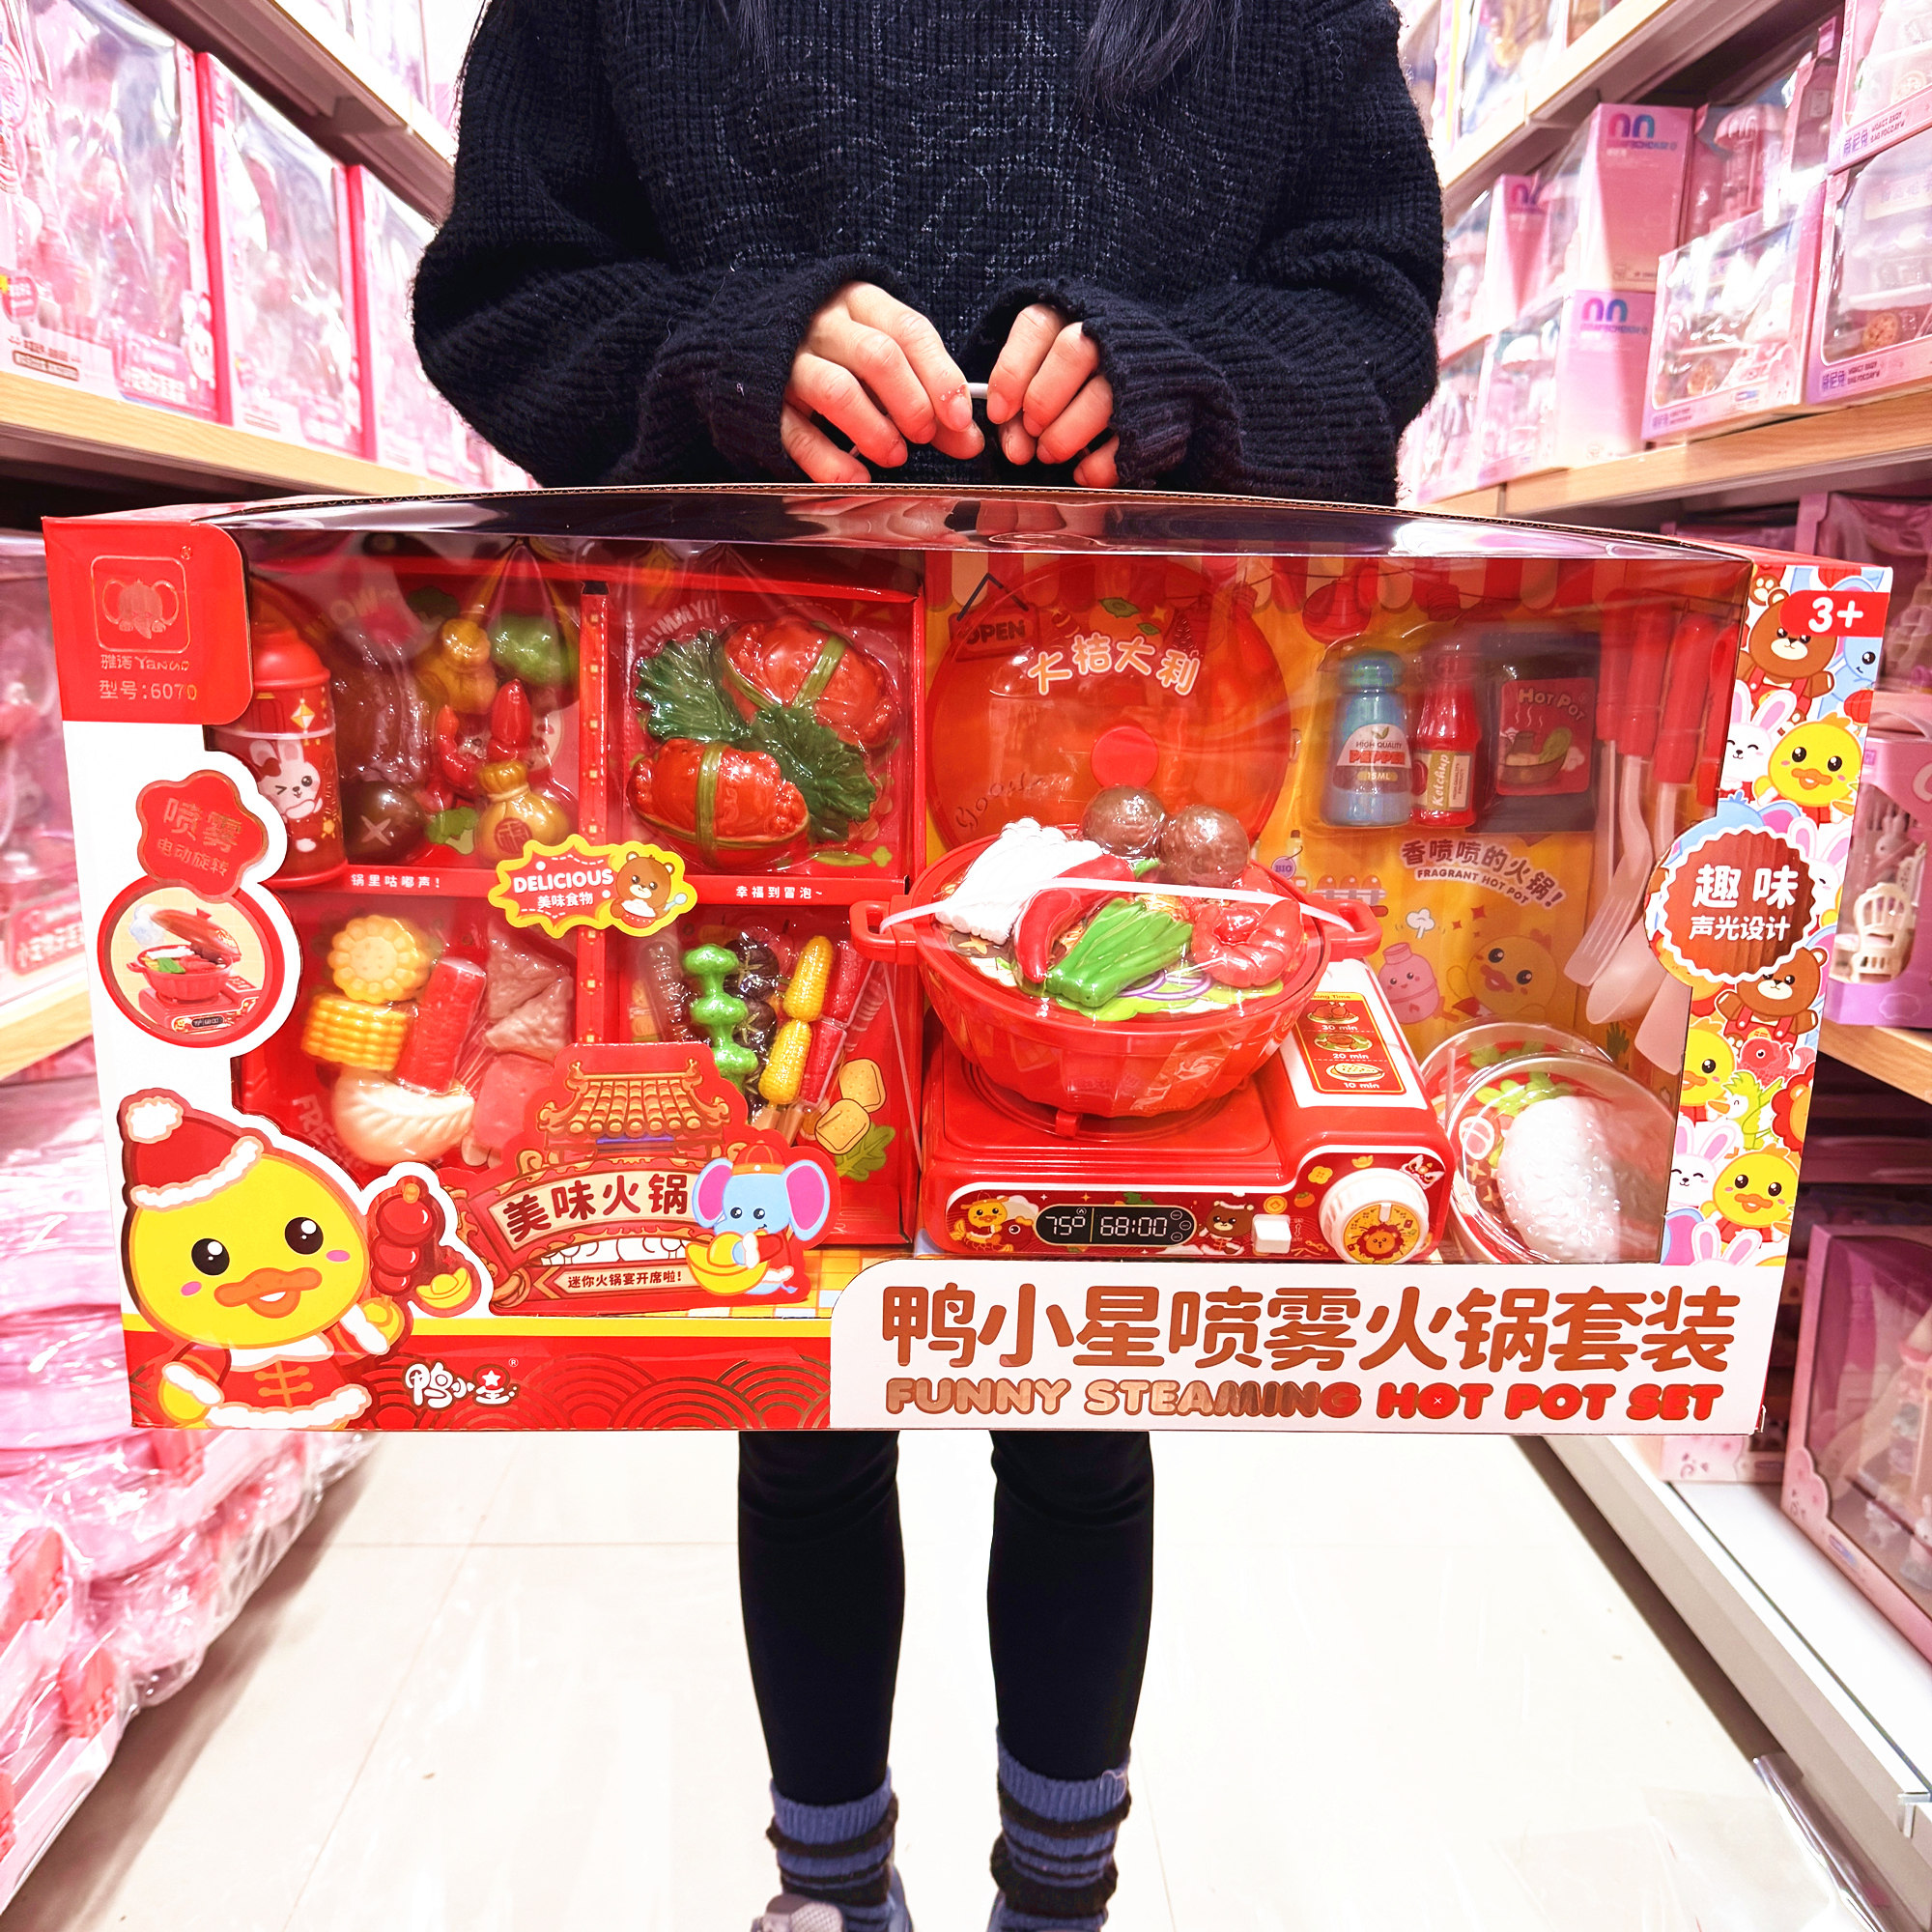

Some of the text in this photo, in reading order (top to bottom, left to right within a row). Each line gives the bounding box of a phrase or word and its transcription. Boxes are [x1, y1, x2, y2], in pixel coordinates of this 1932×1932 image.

[1807, 596, 1864, 634] 3+
[966, 619, 1026, 645] OPEN
[100, 654, 132, 670] 雅诺
[1027, 632, 1201, 696] 大桔大利
[99, 679, 198, 701] 型号:6070
[1367, 771, 1391, 781] 15ML
[156, 837, 230, 877] 电动旋转
[351, 873, 441, 889] 锅里咕嘟声!
[513, 867, 615, 895] DELICIOUS
[1402, 838, 1564, 908] 香喷喷的火锅!
[1416, 867, 1530, 905] FRAGRANT HOT POT
[537, 891, 594, 910] 美味食物
[1688, 914, 1792, 942] 声光设计
[502, 1172, 688, 1243] 美味火锅
[1099, 1216, 1168, 1237] 68:00
[567, 1270, 682, 1290] 迷你火锅宴开席啦!
[882, 1281, 1741, 1373] 鸭小星喷雾火锅套装
[885, 1377, 1724, 1421] FUNNY STEAMING HOT POT SET
